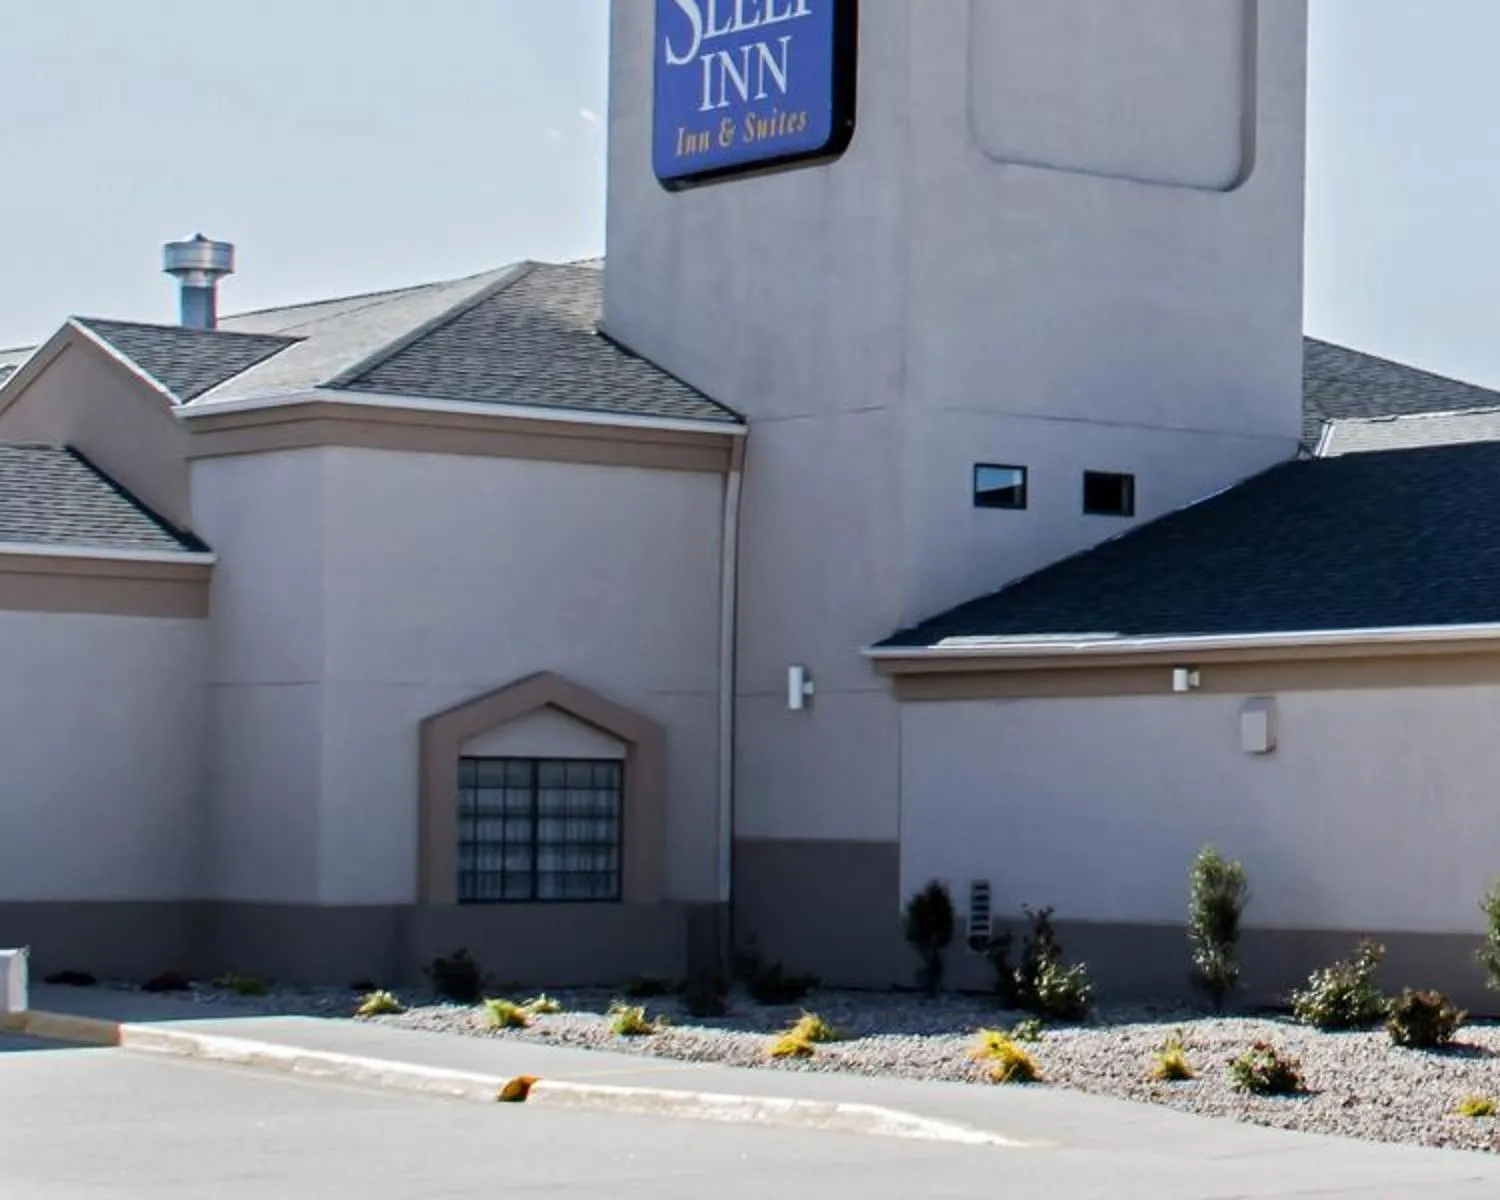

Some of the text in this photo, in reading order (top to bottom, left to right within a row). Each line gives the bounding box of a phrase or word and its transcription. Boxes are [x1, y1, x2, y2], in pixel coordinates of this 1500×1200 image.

[699, 36, 792, 112] INN
[676, 108, 808, 157] Inn & Suites
